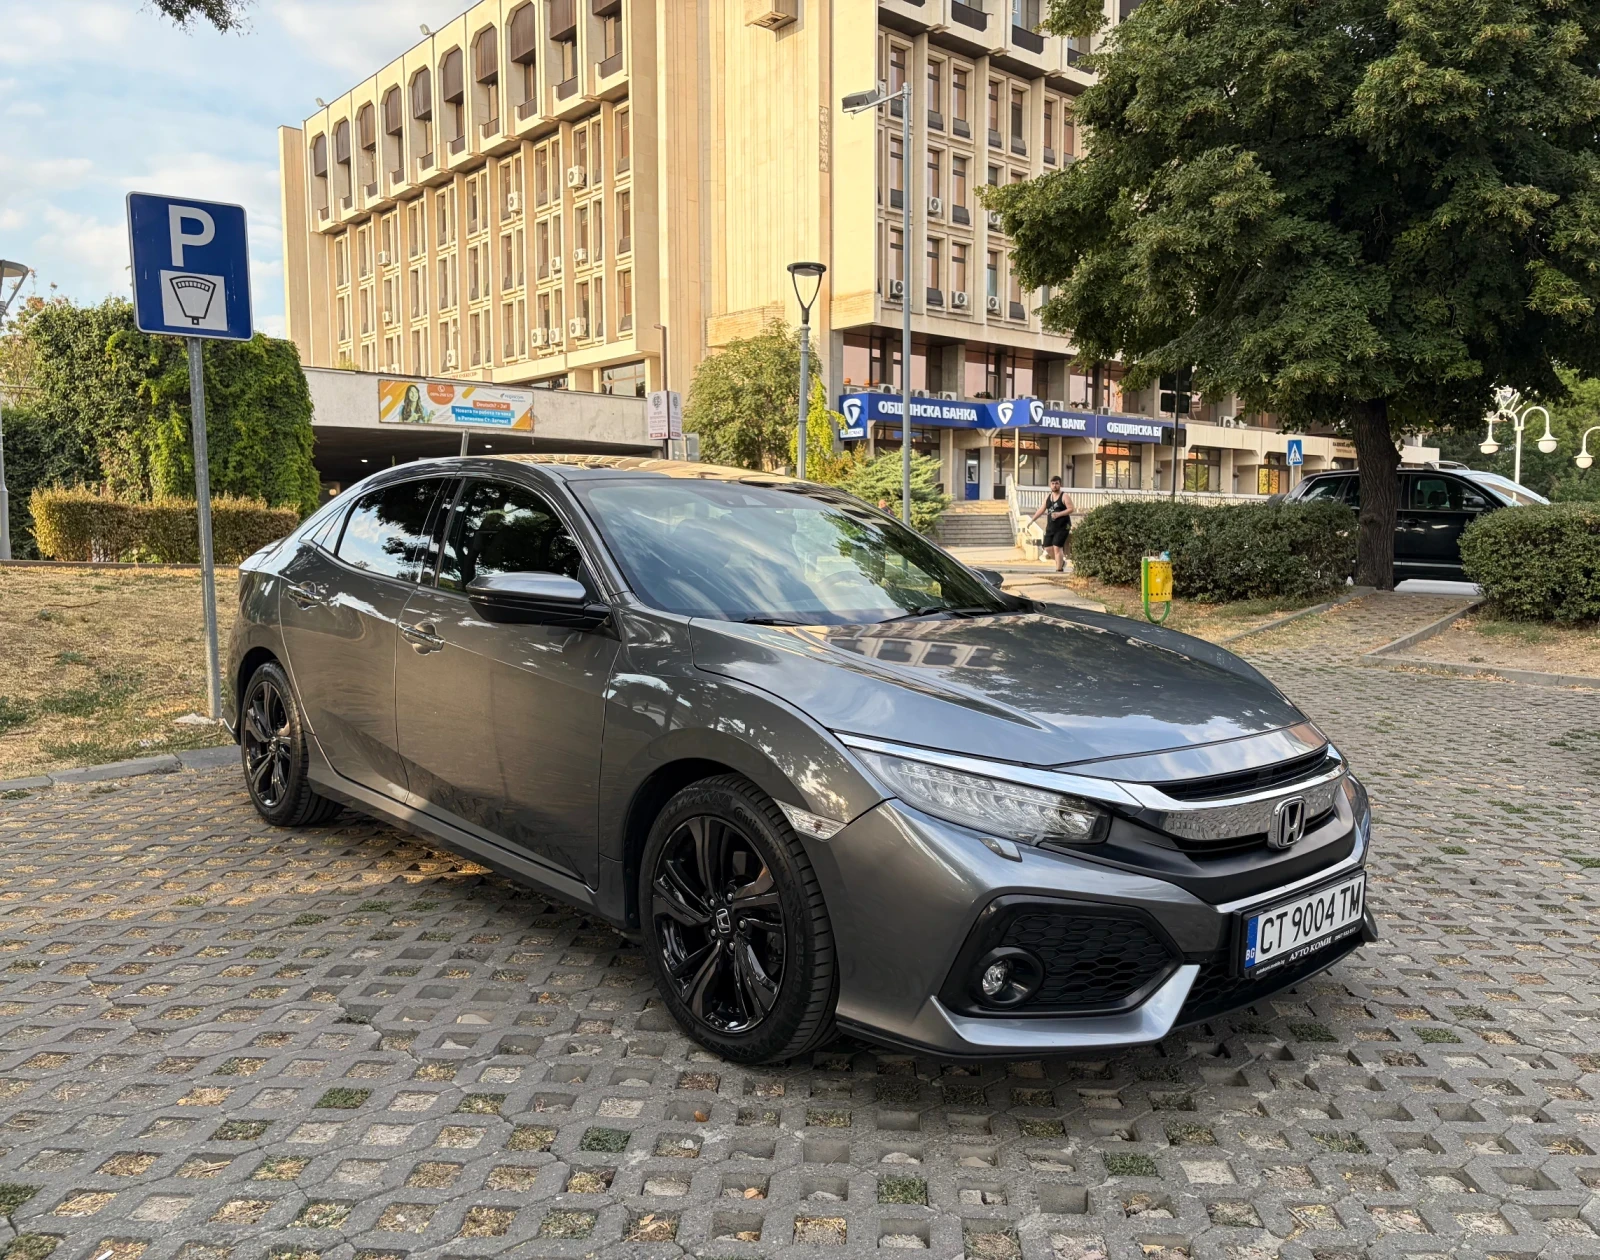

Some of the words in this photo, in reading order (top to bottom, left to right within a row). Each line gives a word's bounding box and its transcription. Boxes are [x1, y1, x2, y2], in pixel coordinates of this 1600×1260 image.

[168, 204, 216, 267] P
[942, 406, 978, 421] БАНКА
[1039, 416, 1061, 428] IPAL
[1061, 417, 1086, 430] BANK
[1106, 422, 1153, 436] ОБЩИНСКА
[1260, 911, 1288, 955] CT
[1292, 892, 1336, 943] 9004
[1340, 881, 1361, 922] TM
[1246, 947, 1256, 960] BG
